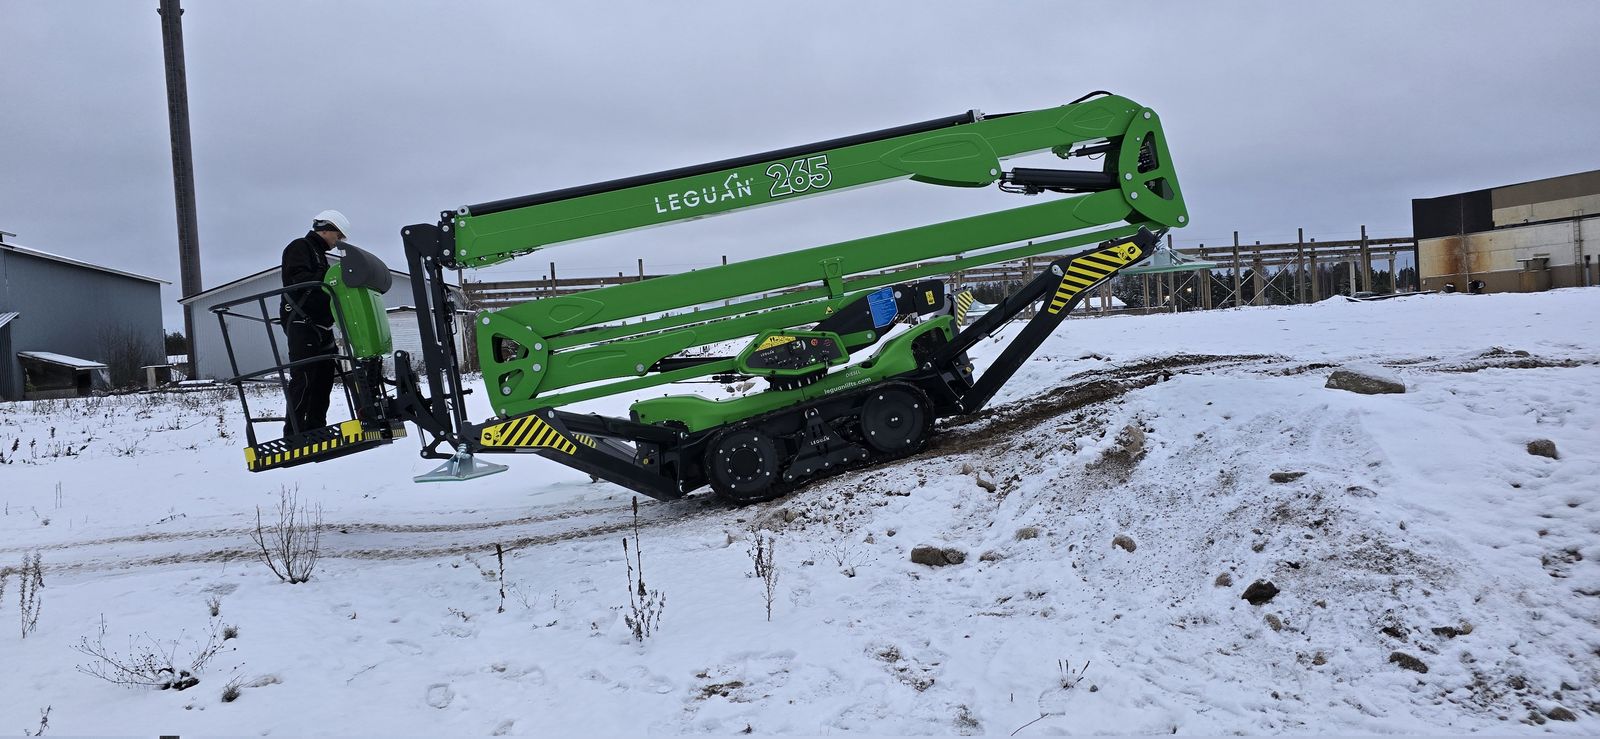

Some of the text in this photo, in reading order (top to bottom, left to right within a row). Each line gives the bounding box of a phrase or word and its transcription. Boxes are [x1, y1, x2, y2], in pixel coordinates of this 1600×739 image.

[654, 154, 833, 214] LEGUAN 265
[823, 377, 872, 395] leguanlifts.com
